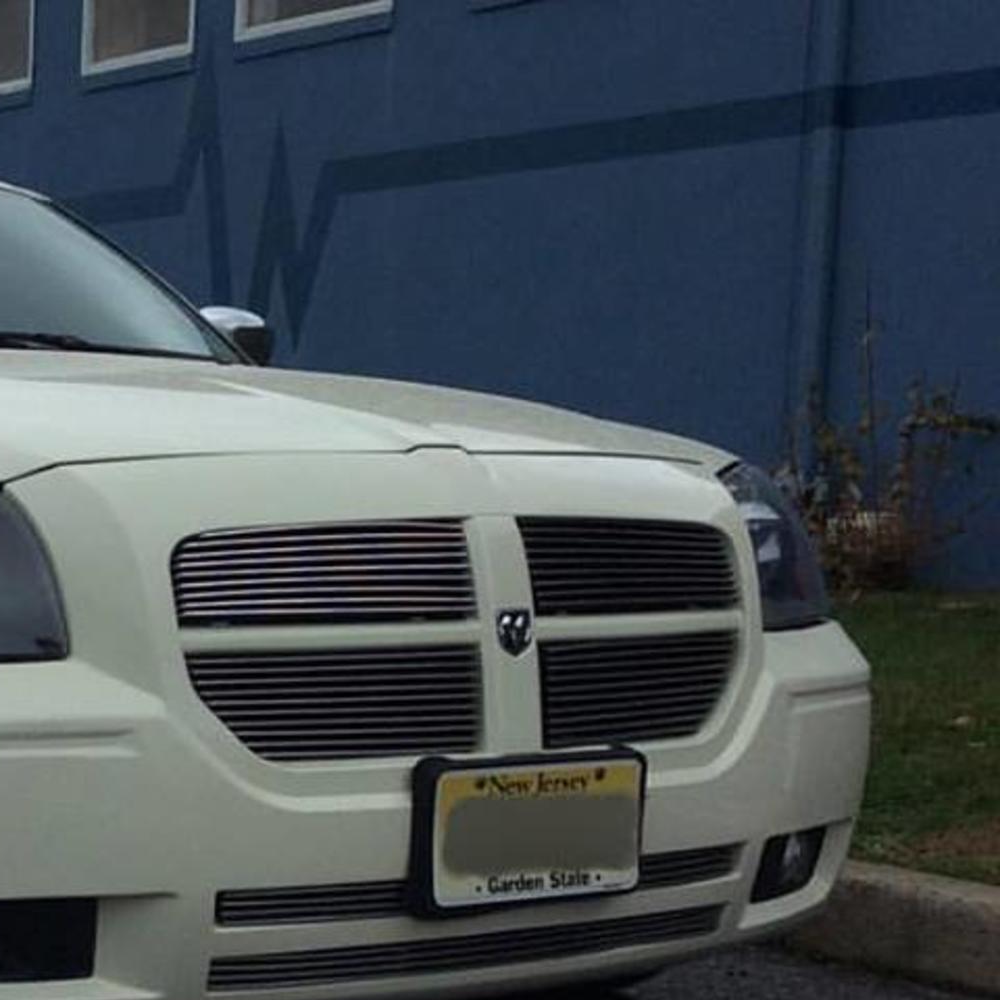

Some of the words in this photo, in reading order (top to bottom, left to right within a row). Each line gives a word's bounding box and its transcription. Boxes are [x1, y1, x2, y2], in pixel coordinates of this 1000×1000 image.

[489, 774, 529, 795] New
[535, 771, 591, 793] Jersey
[487, 873, 544, 894] Garden
[550, 871, 591, 889] State
